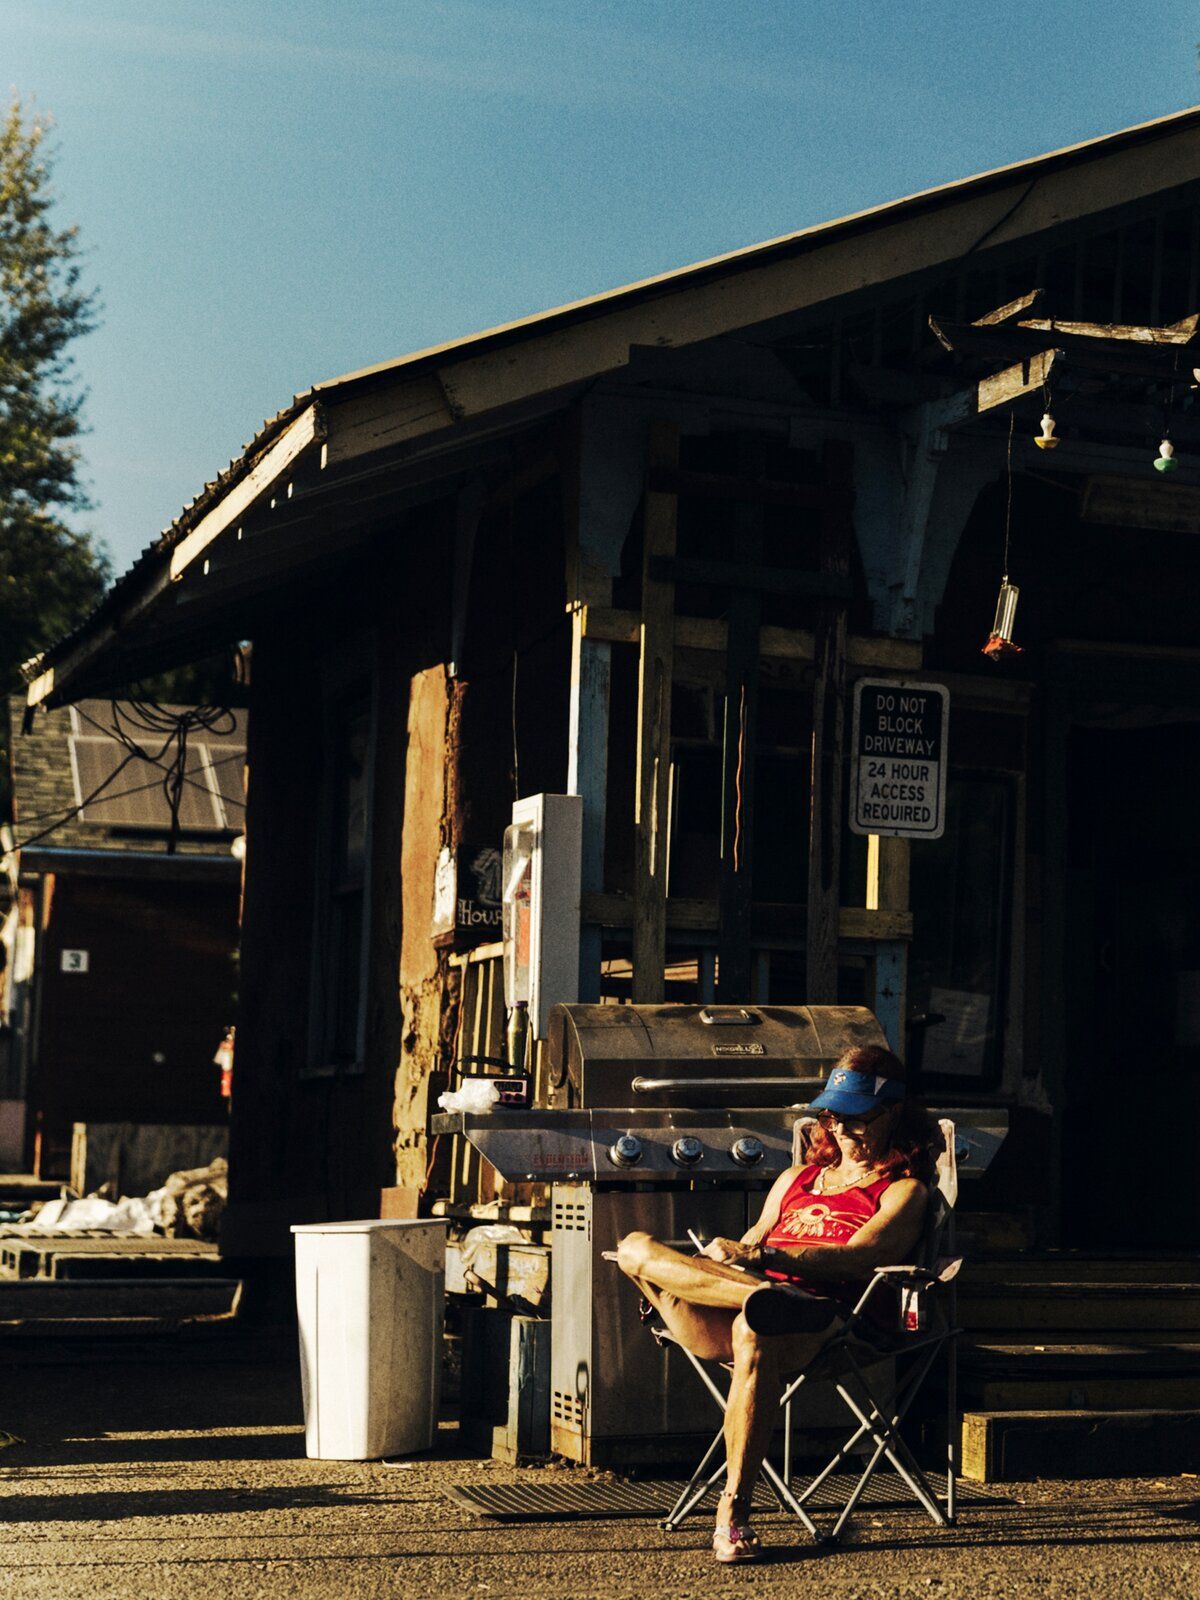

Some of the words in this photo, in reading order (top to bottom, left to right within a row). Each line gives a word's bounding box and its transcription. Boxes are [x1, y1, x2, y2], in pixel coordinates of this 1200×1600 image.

[876, 694, 895, 711] DO
[899, 697, 927, 715] NOT
[878, 715, 923, 735] BLOCK
[864, 735, 936, 756] DRIVEWAY
[868, 761, 887, 779] 24
[891, 763, 930, 782] HOUR
[870, 783, 926, 802] ACCESS
[863, 802, 931, 824] REQUIRED
[69, 952, 81, 969] 3
